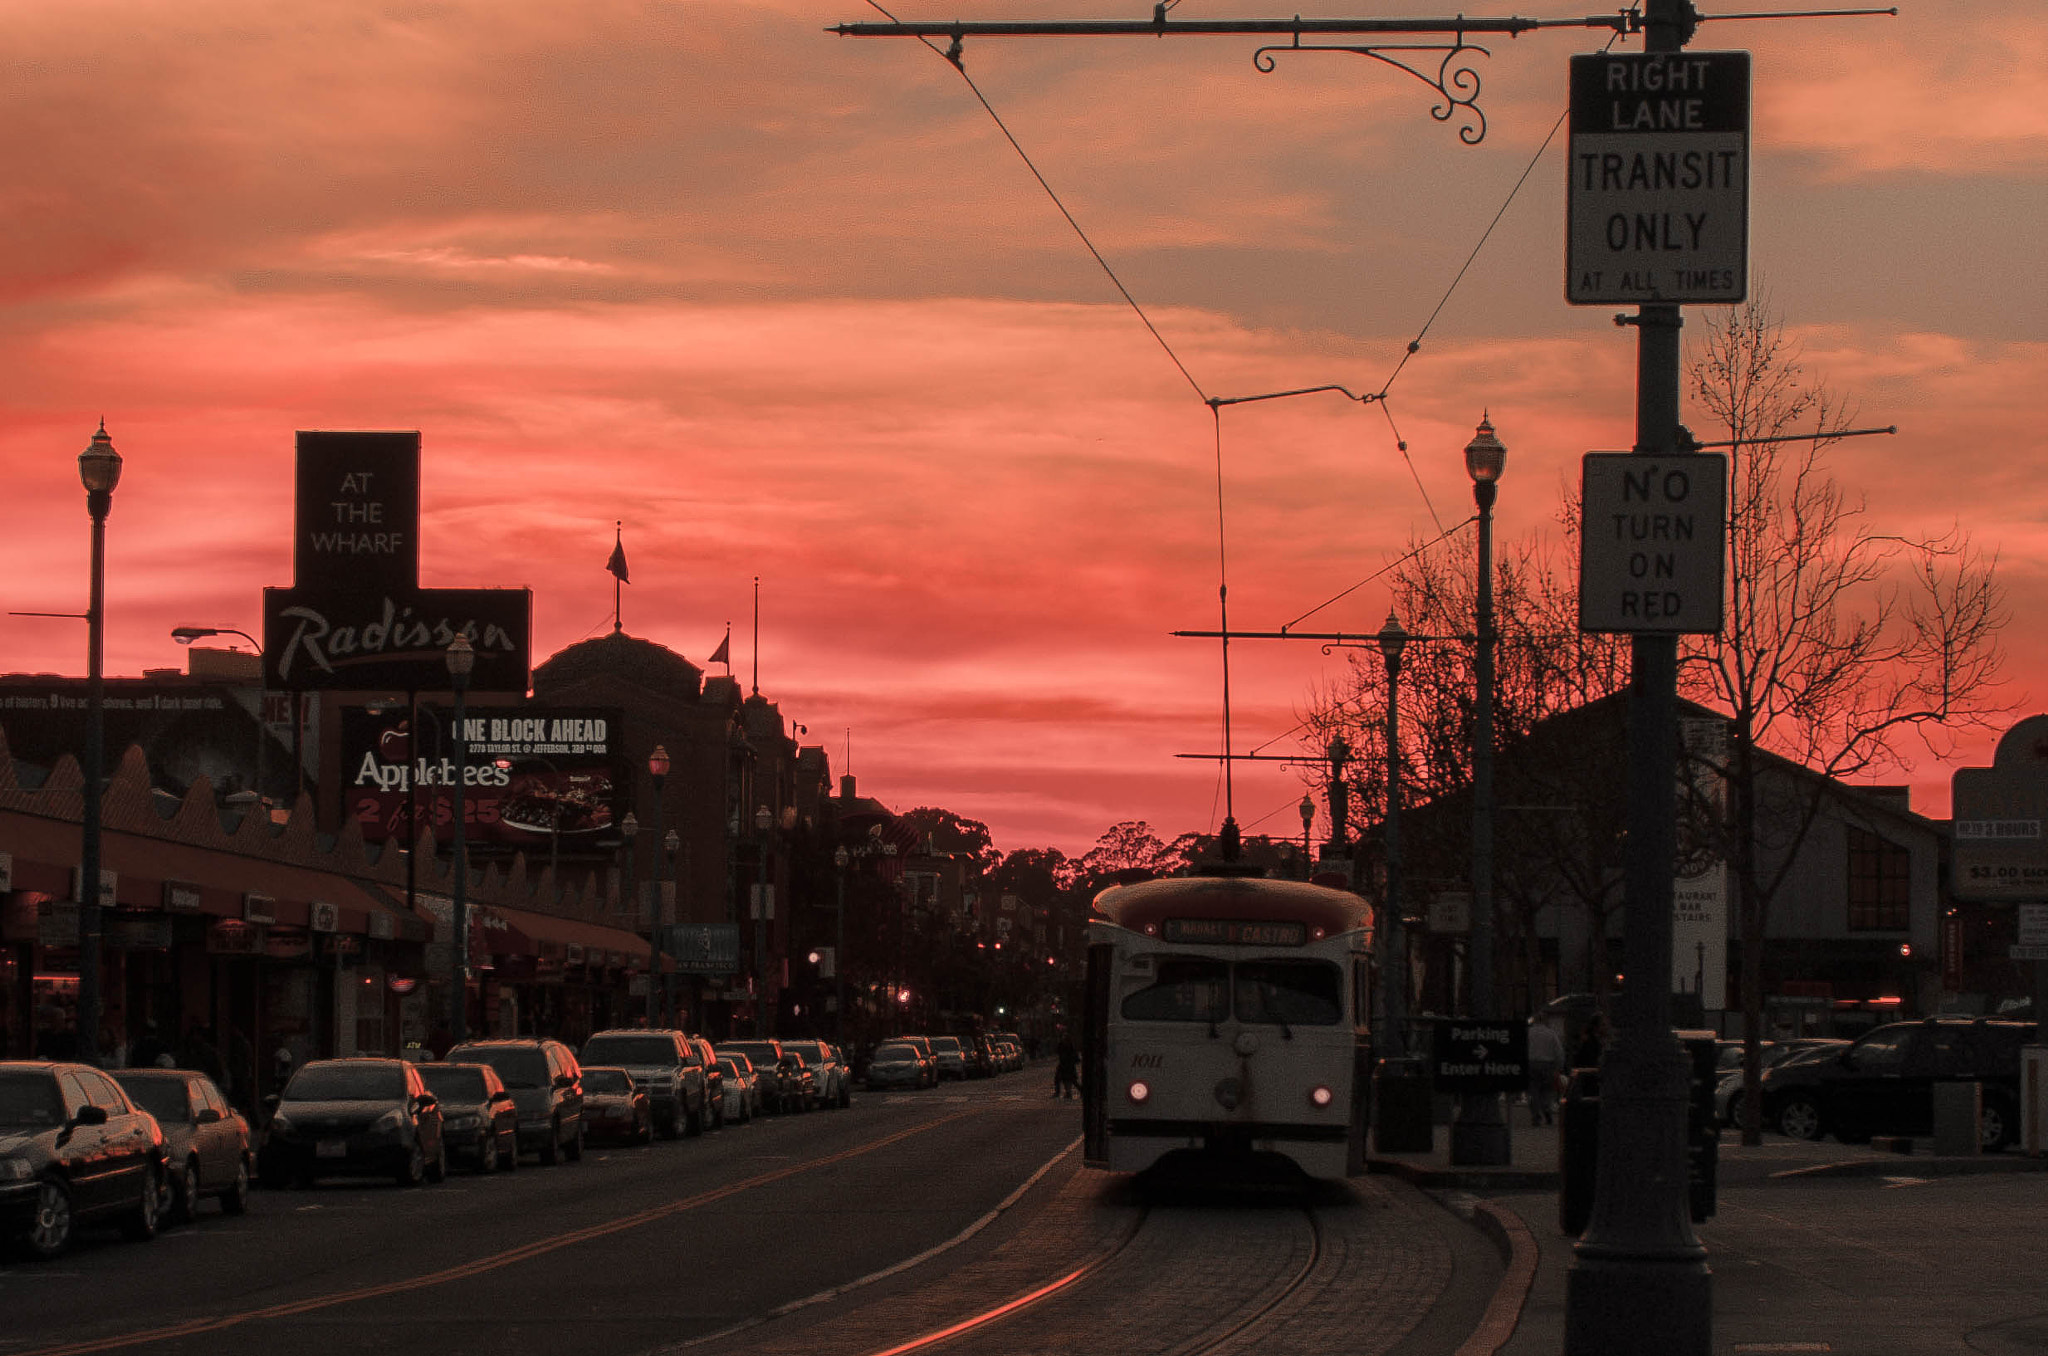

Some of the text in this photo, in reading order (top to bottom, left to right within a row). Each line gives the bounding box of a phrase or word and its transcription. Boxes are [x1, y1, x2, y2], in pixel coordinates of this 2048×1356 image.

[1605, 60, 1710, 92] RIGHT
[1612, 99, 1704, 129] LANE
[1580, 152, 1737, 191] TRANSIT
[1606, 212, 1706, 251] ONLY
[1581, 270, 1733, 291] AT ALL TIMES
[340, 472, 374, 493] AT
[1623, 469, 1690, 502] NO
[331, 502, 384, 524] THE
[1612, 514, 1693, 541] TURN
[310, 532, 404, 554] WHARF
[1630, 552, 1674, 579] ON
[1621, 591, 1681, 617] RED
[278, 597, 517, 681] Radisson
[490, 718, 547, 742] BLOCK
[550, 718, 607, 742] AHEAD
[356, 798, 381, 823] 2
[1996, 822, 2038, 836] HOURS
[1970, 864, 2018, 879] $3.00
[1451, 1026, 1510, 1044] Parking
[1440, 1062, 1521, 1077] Enter Here
